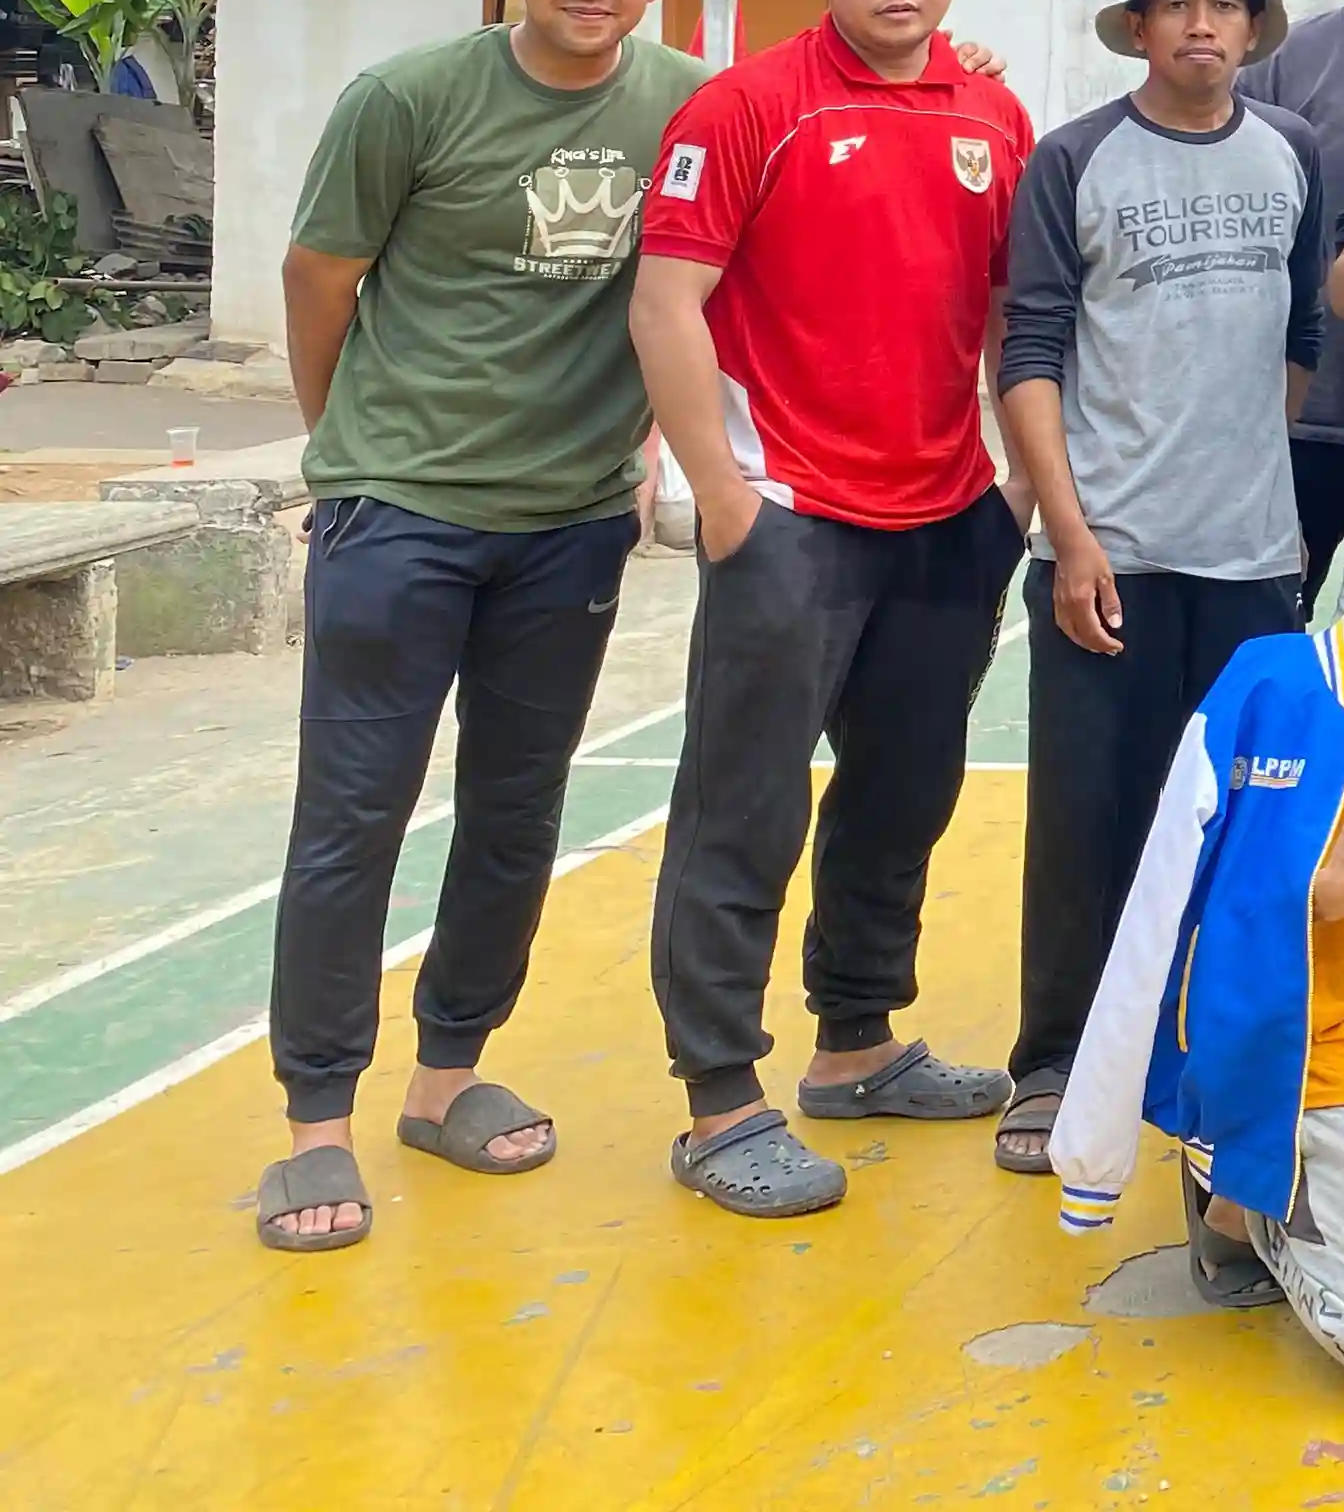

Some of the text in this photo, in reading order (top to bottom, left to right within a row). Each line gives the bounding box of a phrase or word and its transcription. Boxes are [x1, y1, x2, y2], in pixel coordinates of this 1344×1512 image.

[1116, 192, 1288, 229] RELIGIOUS
[1123, 215, 1285, 252] TOURISME
[1250, 755, 1306, 778] LPPM
